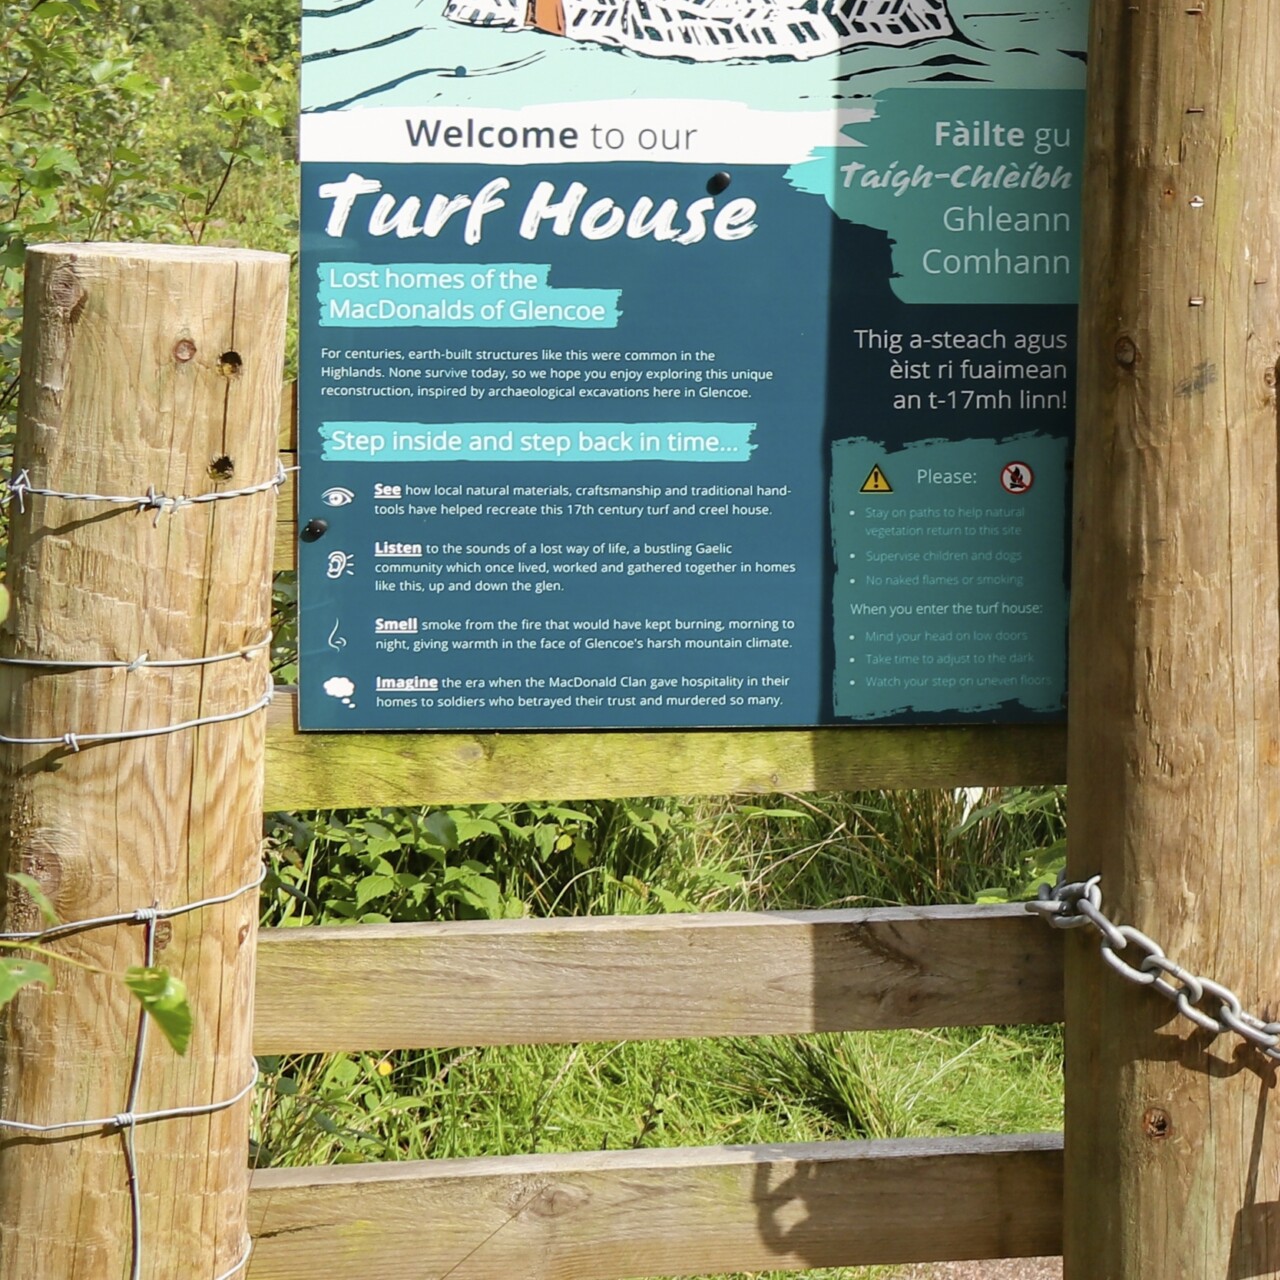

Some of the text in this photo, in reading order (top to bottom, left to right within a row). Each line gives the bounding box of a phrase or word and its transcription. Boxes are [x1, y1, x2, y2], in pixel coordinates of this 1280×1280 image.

[405, 118, 697, 150] Welcome to our
[936, 120, 1069, 155] Fàilte gu
[318, 172, 758, 246] Turf House
[943, 205, 1070, 232] Ghleann
[922, 247, 1070, 275] Comhann
[330, 268, 538, 290] Lost homes of the
[329, 298, 606, 321] MacDonalds of Glencoe
[852, 328, 1068, 355] Thig a-steach agus
[321, 347, 716, 362] For centuries, earth-built structures like this were common in the
[321, 366, 774, 383] Highlands. None survive today, so we hope you enjoy exploring this unique
[890, 359, 1067, 379] èist ri fuaimean
[893, 389, 1066, 410] an t-17mh linn!
[331, 430, 738, 457] Step inside and step back in time...
[917, 468, 977, 485] Please:
[373, 482, 792, 500] See how local natural materials, craftsmanship and traditional hand-
[374, 503, 773, 518] tools have helped recreate this 17th century turf and creel house.
[373, 540, 733, 558] Listen to the sounds of a lost way of life, a bustling Gaelic
[374, 561, 797, 576] community which once lived, worked and gathered together in homes
[849, 601, 1043, 619] When you enter the turf house:
[374, 617, 795, 635] Smell smoke from the fire that would have kept burning, morning to
[375, 636, 793, 653] night, giving warmth in the face of Glencoe's harsh mountain climate.
[375, 675, 790, 692] Imagine the era when the MacDonald Clan gave hospitality in their
[376, 694, 784, 710] homes to soldiers who betrayed their trust and murdered so many.
